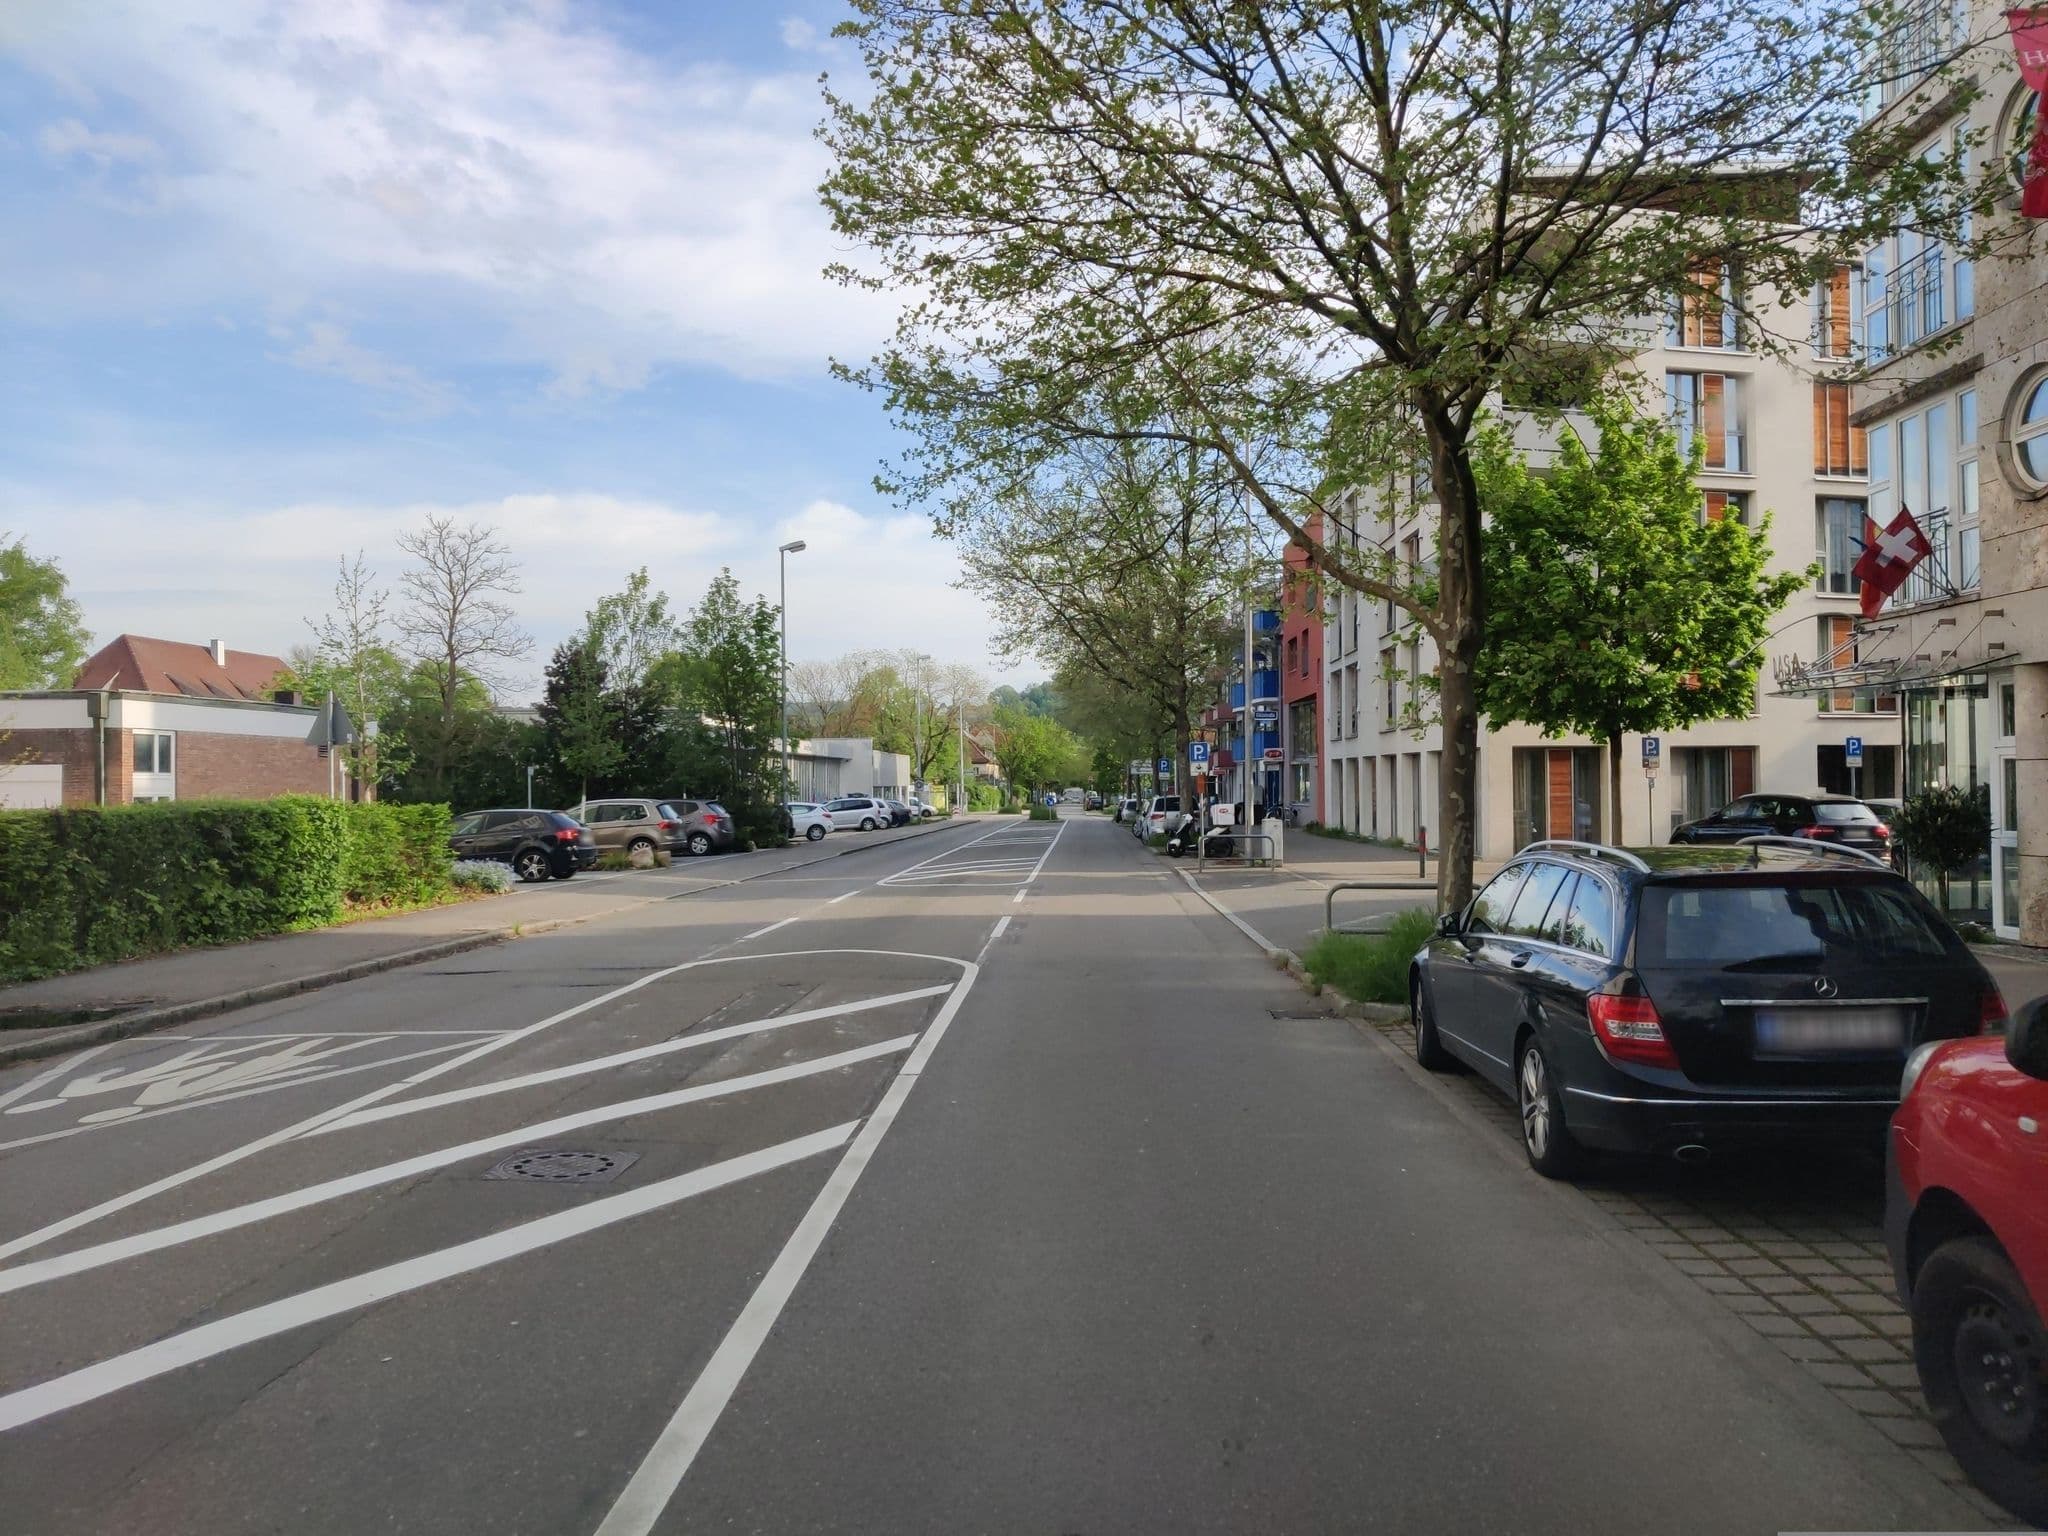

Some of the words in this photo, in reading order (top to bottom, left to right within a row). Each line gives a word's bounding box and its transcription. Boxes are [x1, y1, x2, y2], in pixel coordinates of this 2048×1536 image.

[1194, 745, 1204, 760] P
[1646, 740, 1656, 755] P
[1850, 740, 1858, 754] P
